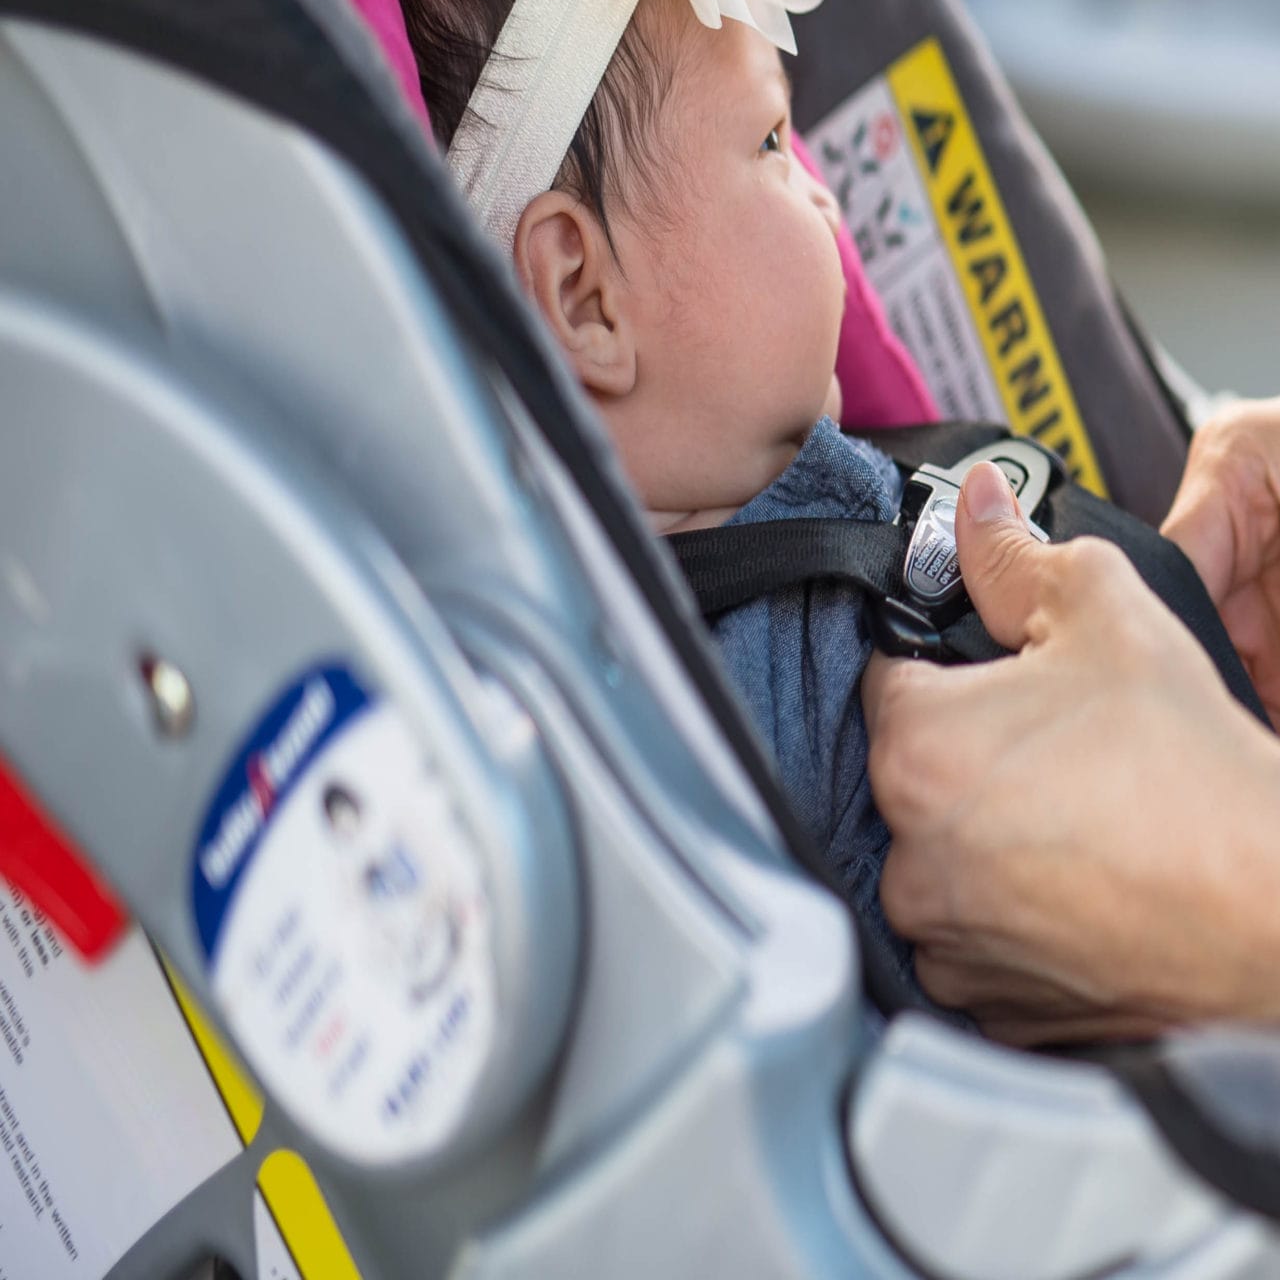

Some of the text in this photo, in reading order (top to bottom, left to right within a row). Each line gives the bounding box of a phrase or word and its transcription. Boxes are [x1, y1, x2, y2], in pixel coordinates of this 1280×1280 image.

[914, 530, 939, 570] CORREC
[940, 570, 954, 586] ON
[21, 908, 32, 928] or
[3, 913, 34, 978] with this
[44, 926, 64, 959] and
[16, 1132, 36, 1163] and
[31, 1162, 41, 1181] in
[39, 1180, 53, 1208] the
[52, 1208, 79, 1262] written
